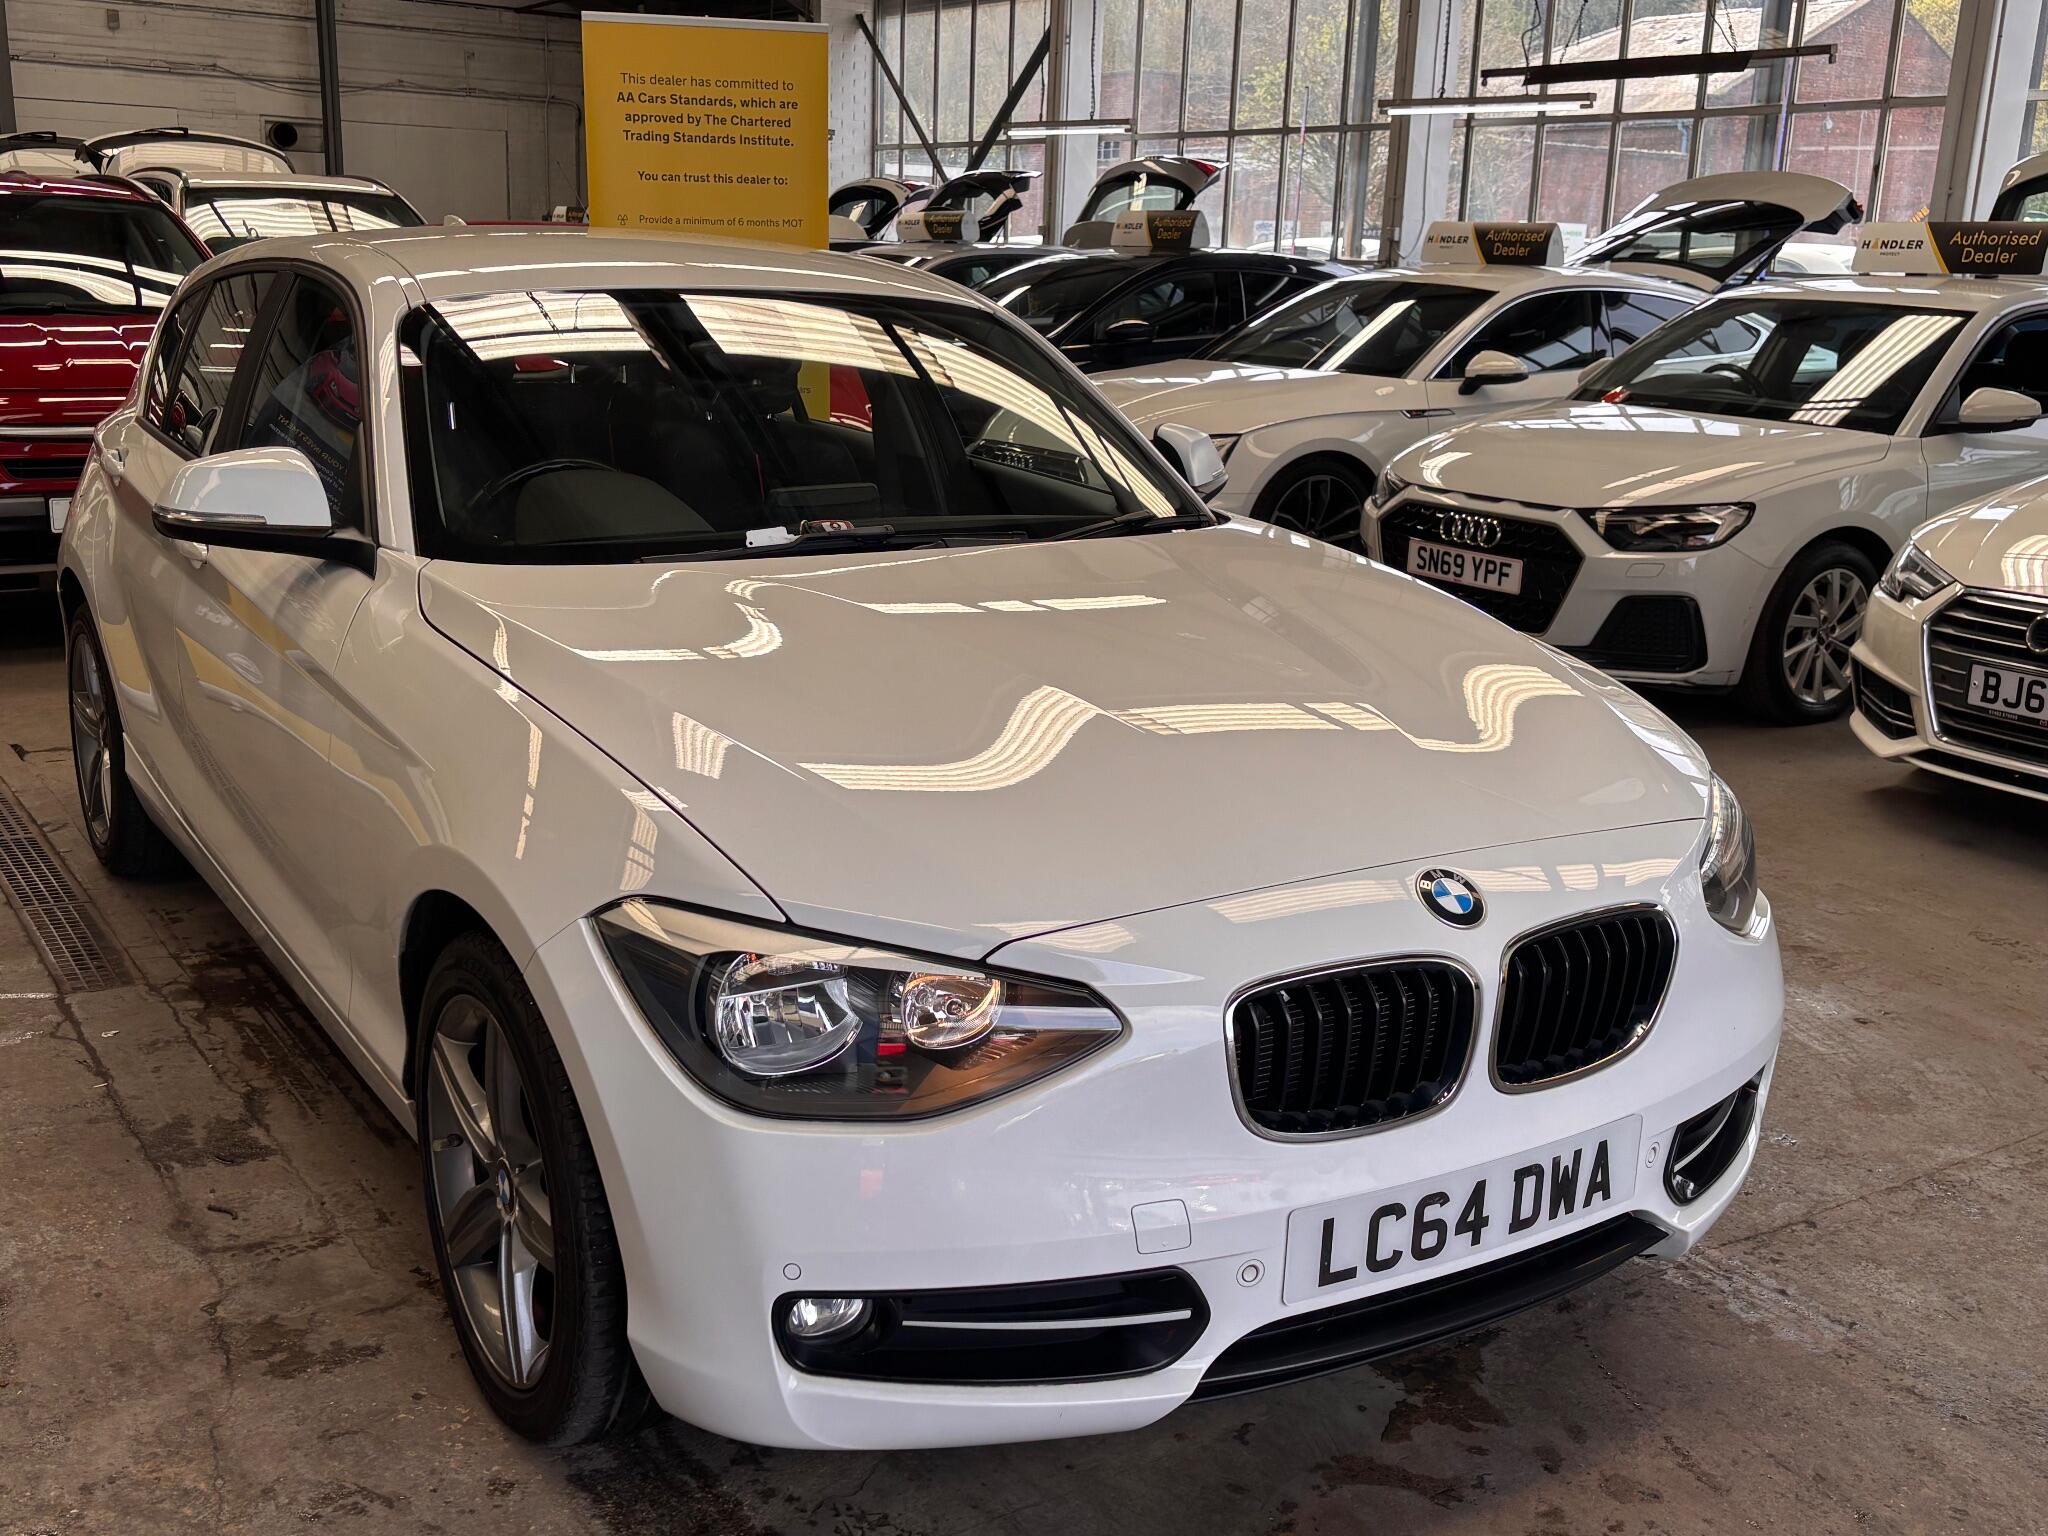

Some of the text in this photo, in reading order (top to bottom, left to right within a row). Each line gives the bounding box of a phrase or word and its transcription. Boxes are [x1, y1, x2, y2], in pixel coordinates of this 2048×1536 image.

[620, 71, 794, 91] This dealer has committed to
[616, 91, 798, 110] AA Cars Standards, which are
[624, 112, 791, 128] approved by The Chartered
[623, 129, 794, 147] Trading Standards Institute.
[638, 170, 788, 186] You can trust this dealer to:
[639, 214, 673, 225] Provide
[683, 216, 725, 226] minimum
[727, 217, 736, 226] of
[737, 217, 744, 226] 6
[746, 218, 780, 228] months
[782, 219, 804, 228] MOT
[929, 214, 960, 223] Authorised
[1153, 215, 1192, 227] Authorised
[934, 223, 953, 234] Dealer
[1157, 228, 1182, 239] Dealer
[1485, 229, 1546, 243] Authorised
[1427, 233, 1469, 244] HANDLER
[1861, 238, 1924, 250] HANDLER
[1950, 230, 2042, 246] Authorised
[1493, 243, 1530, 257] Dealer
[1961, 247, 2017, 263] Dealer
[1416, 546, 1512, 586] SN69 YPF
[1980, 669, 2047, 713] BJ6
[1419, 869, 1467, 890] BMW
[1318, 1139, 1611, 1288] LC64 DWA
